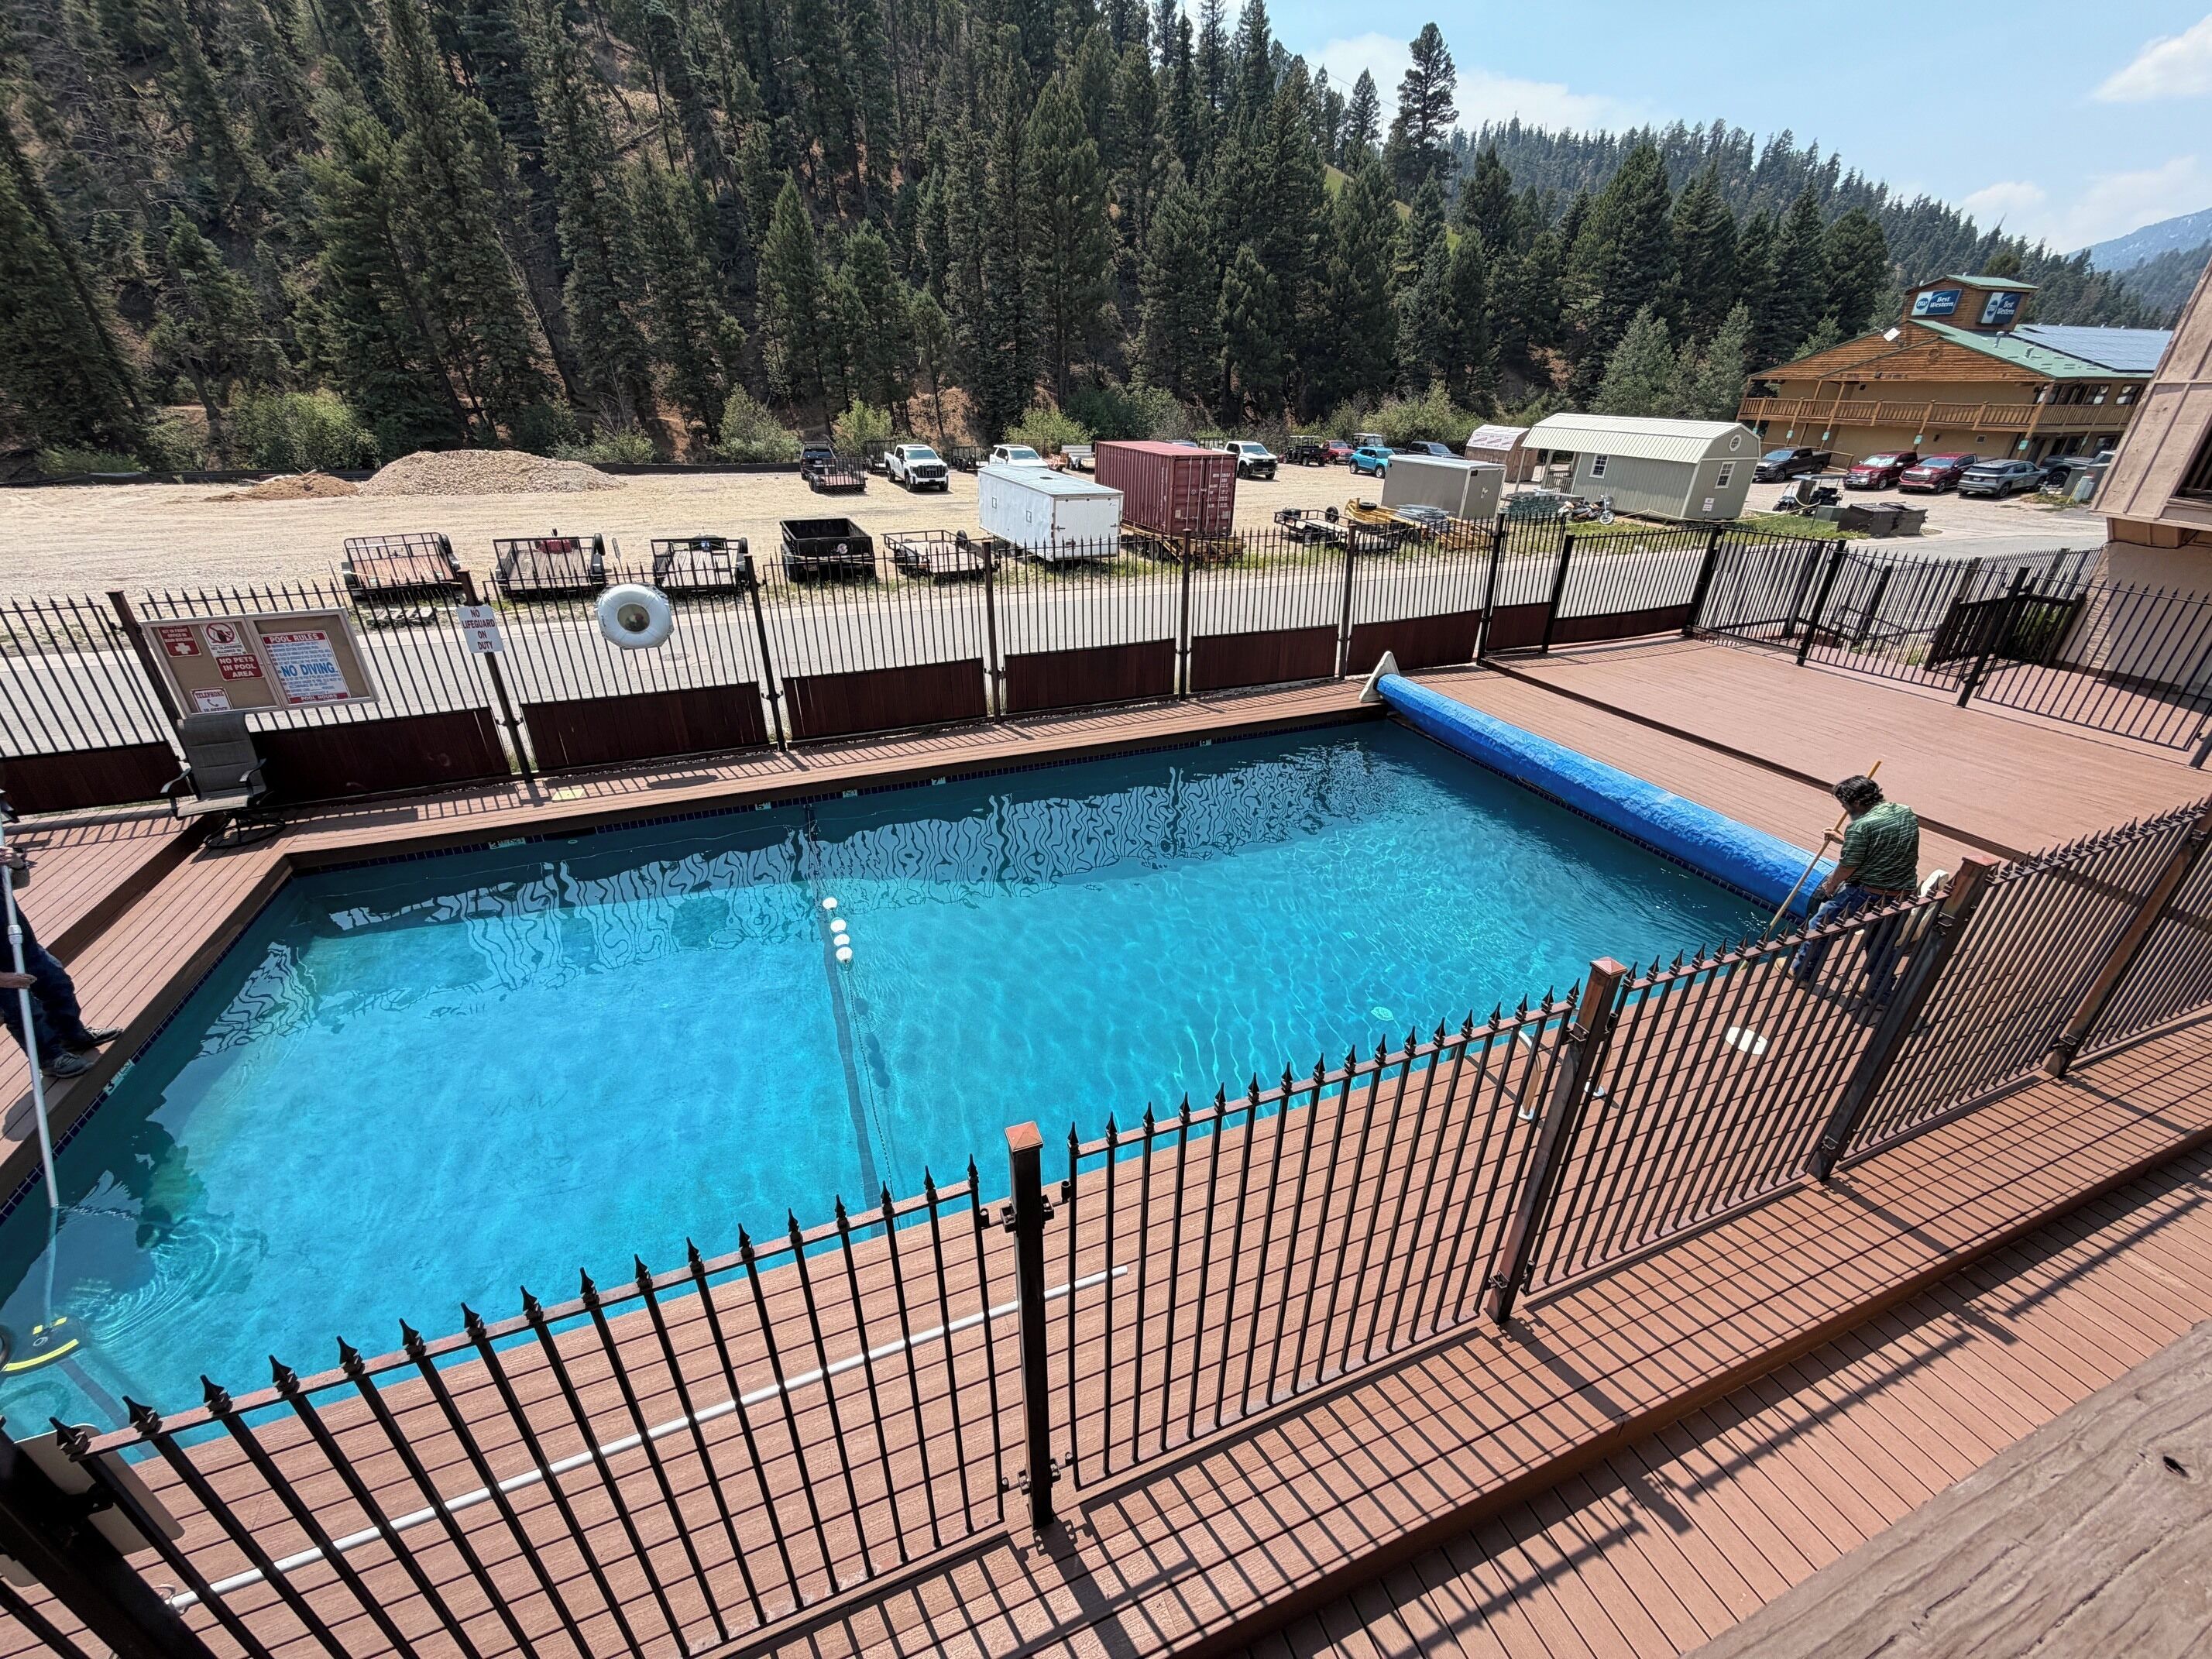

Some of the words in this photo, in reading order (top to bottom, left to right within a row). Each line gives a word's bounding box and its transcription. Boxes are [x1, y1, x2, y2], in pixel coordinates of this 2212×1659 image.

[470, 609, 480, 618] NO
[462, 619, 496, 629] LIFEGUARD
[477, 630, 487, 639] ON
[477, 641, 493, 650] DUTY
[280, 665, 297, 678] NO
[300, 661, 338, 675] DIVING.
